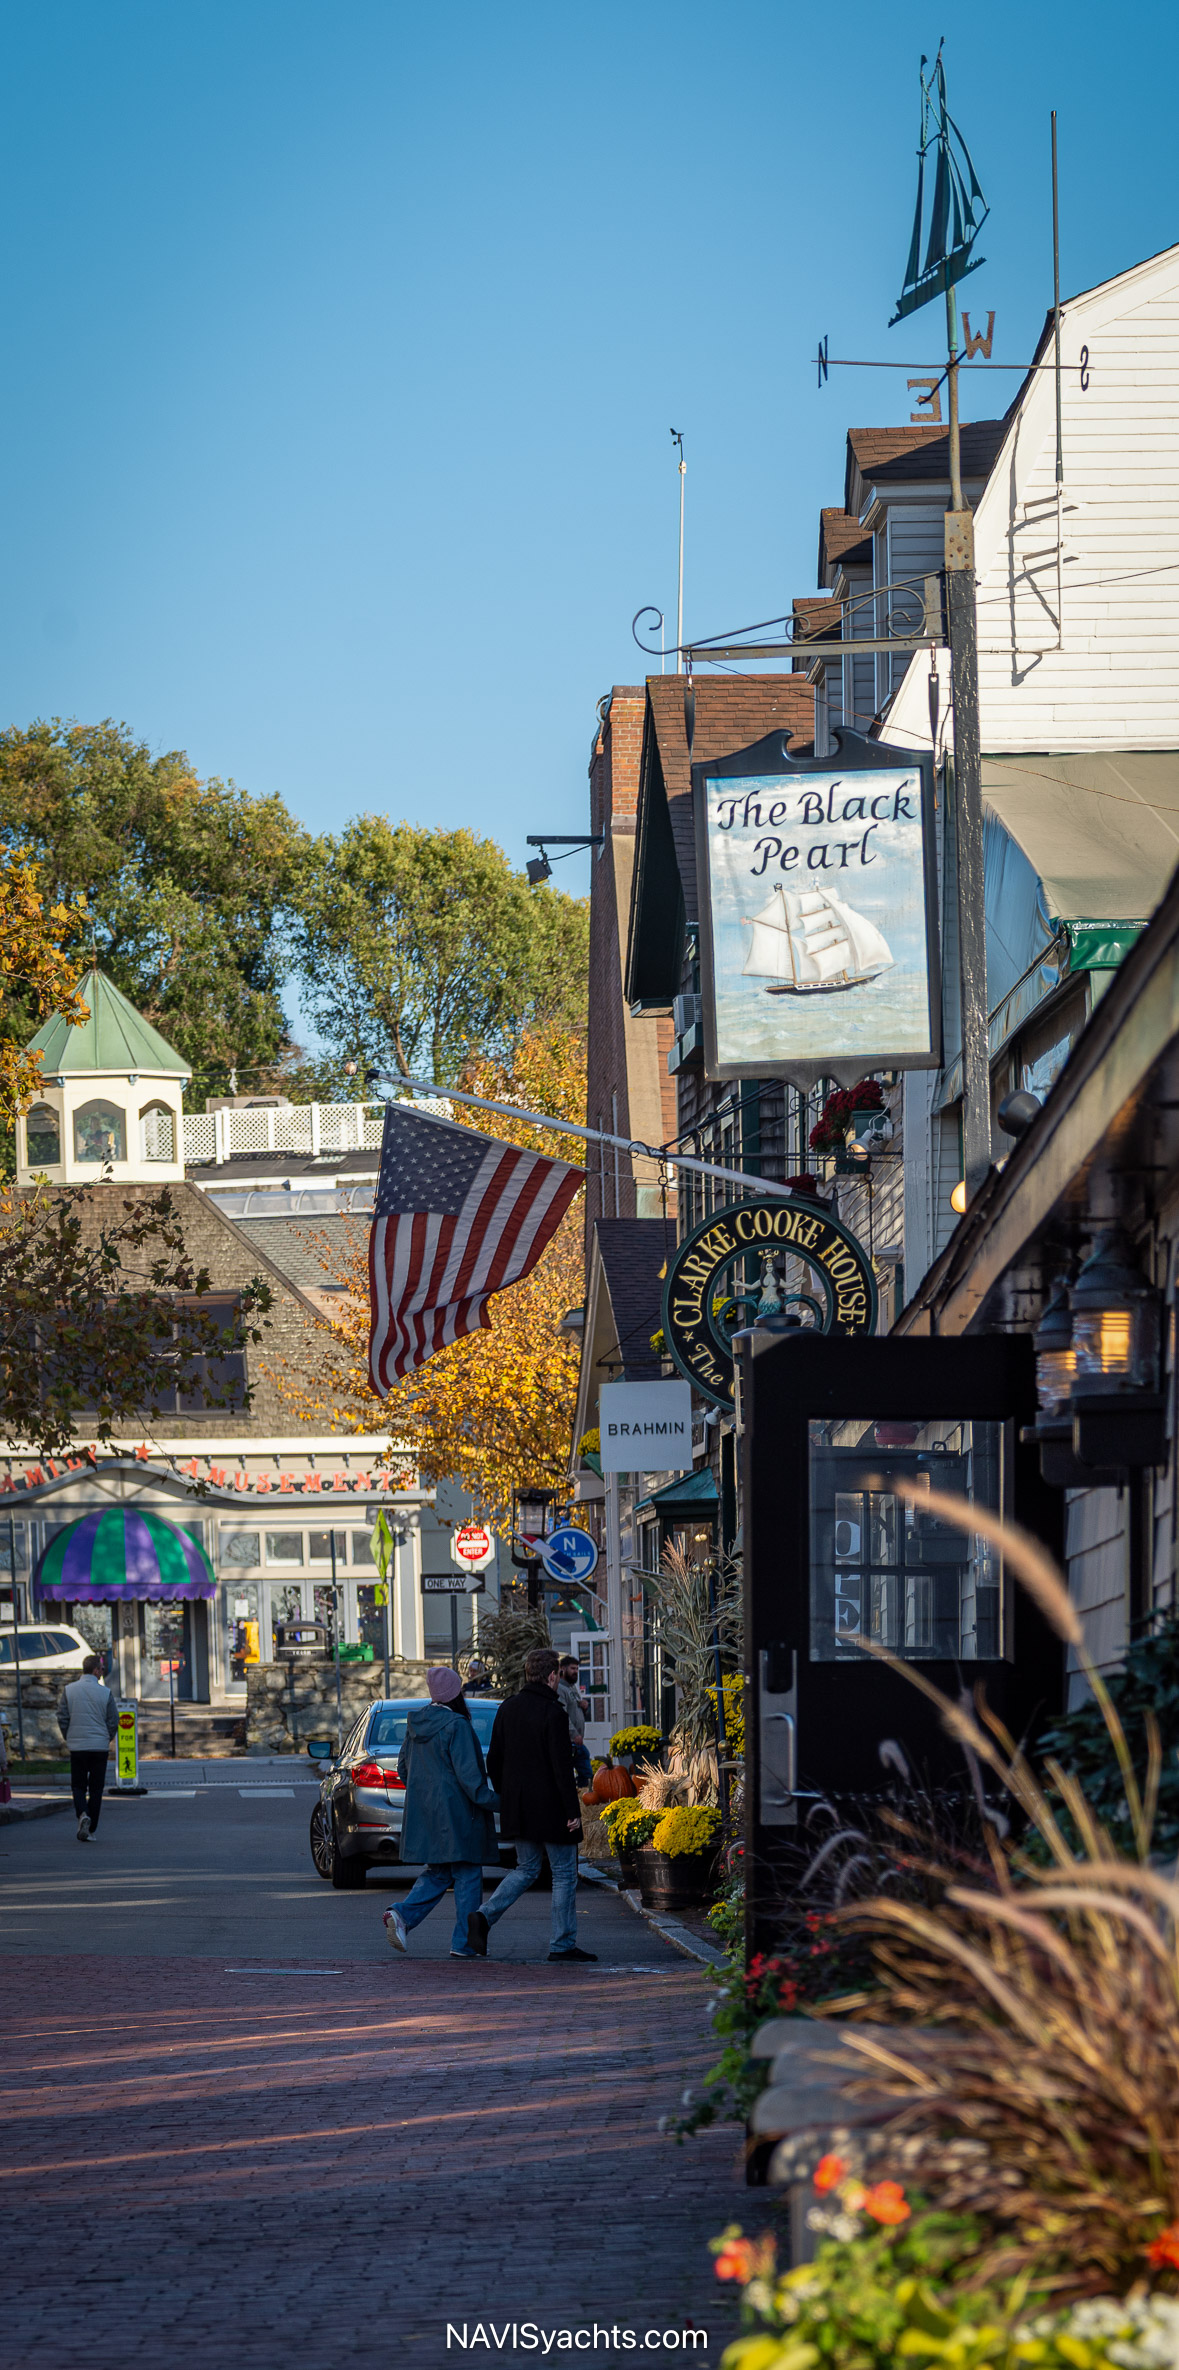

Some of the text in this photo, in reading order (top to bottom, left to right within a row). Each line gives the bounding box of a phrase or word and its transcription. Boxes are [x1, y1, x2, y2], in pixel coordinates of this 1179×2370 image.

[960, 310, 996, 360] W
[716, 779, 918, 830] The Black
[750, 823, 879, 876] Pearl
[673, 1208, 867, 1328] CLARKE COOKE HOUSE
[687, 1343, 724, 1386] The
[608, 1421, 685, 1436] BRAHMIN
[471, 1532, 484, 1540] NOT
[563, 1536, 577, 1551] N
[462, 1547, 484, 1556] ENTER
[427, 1578, 467, 1589] ONE WAY
